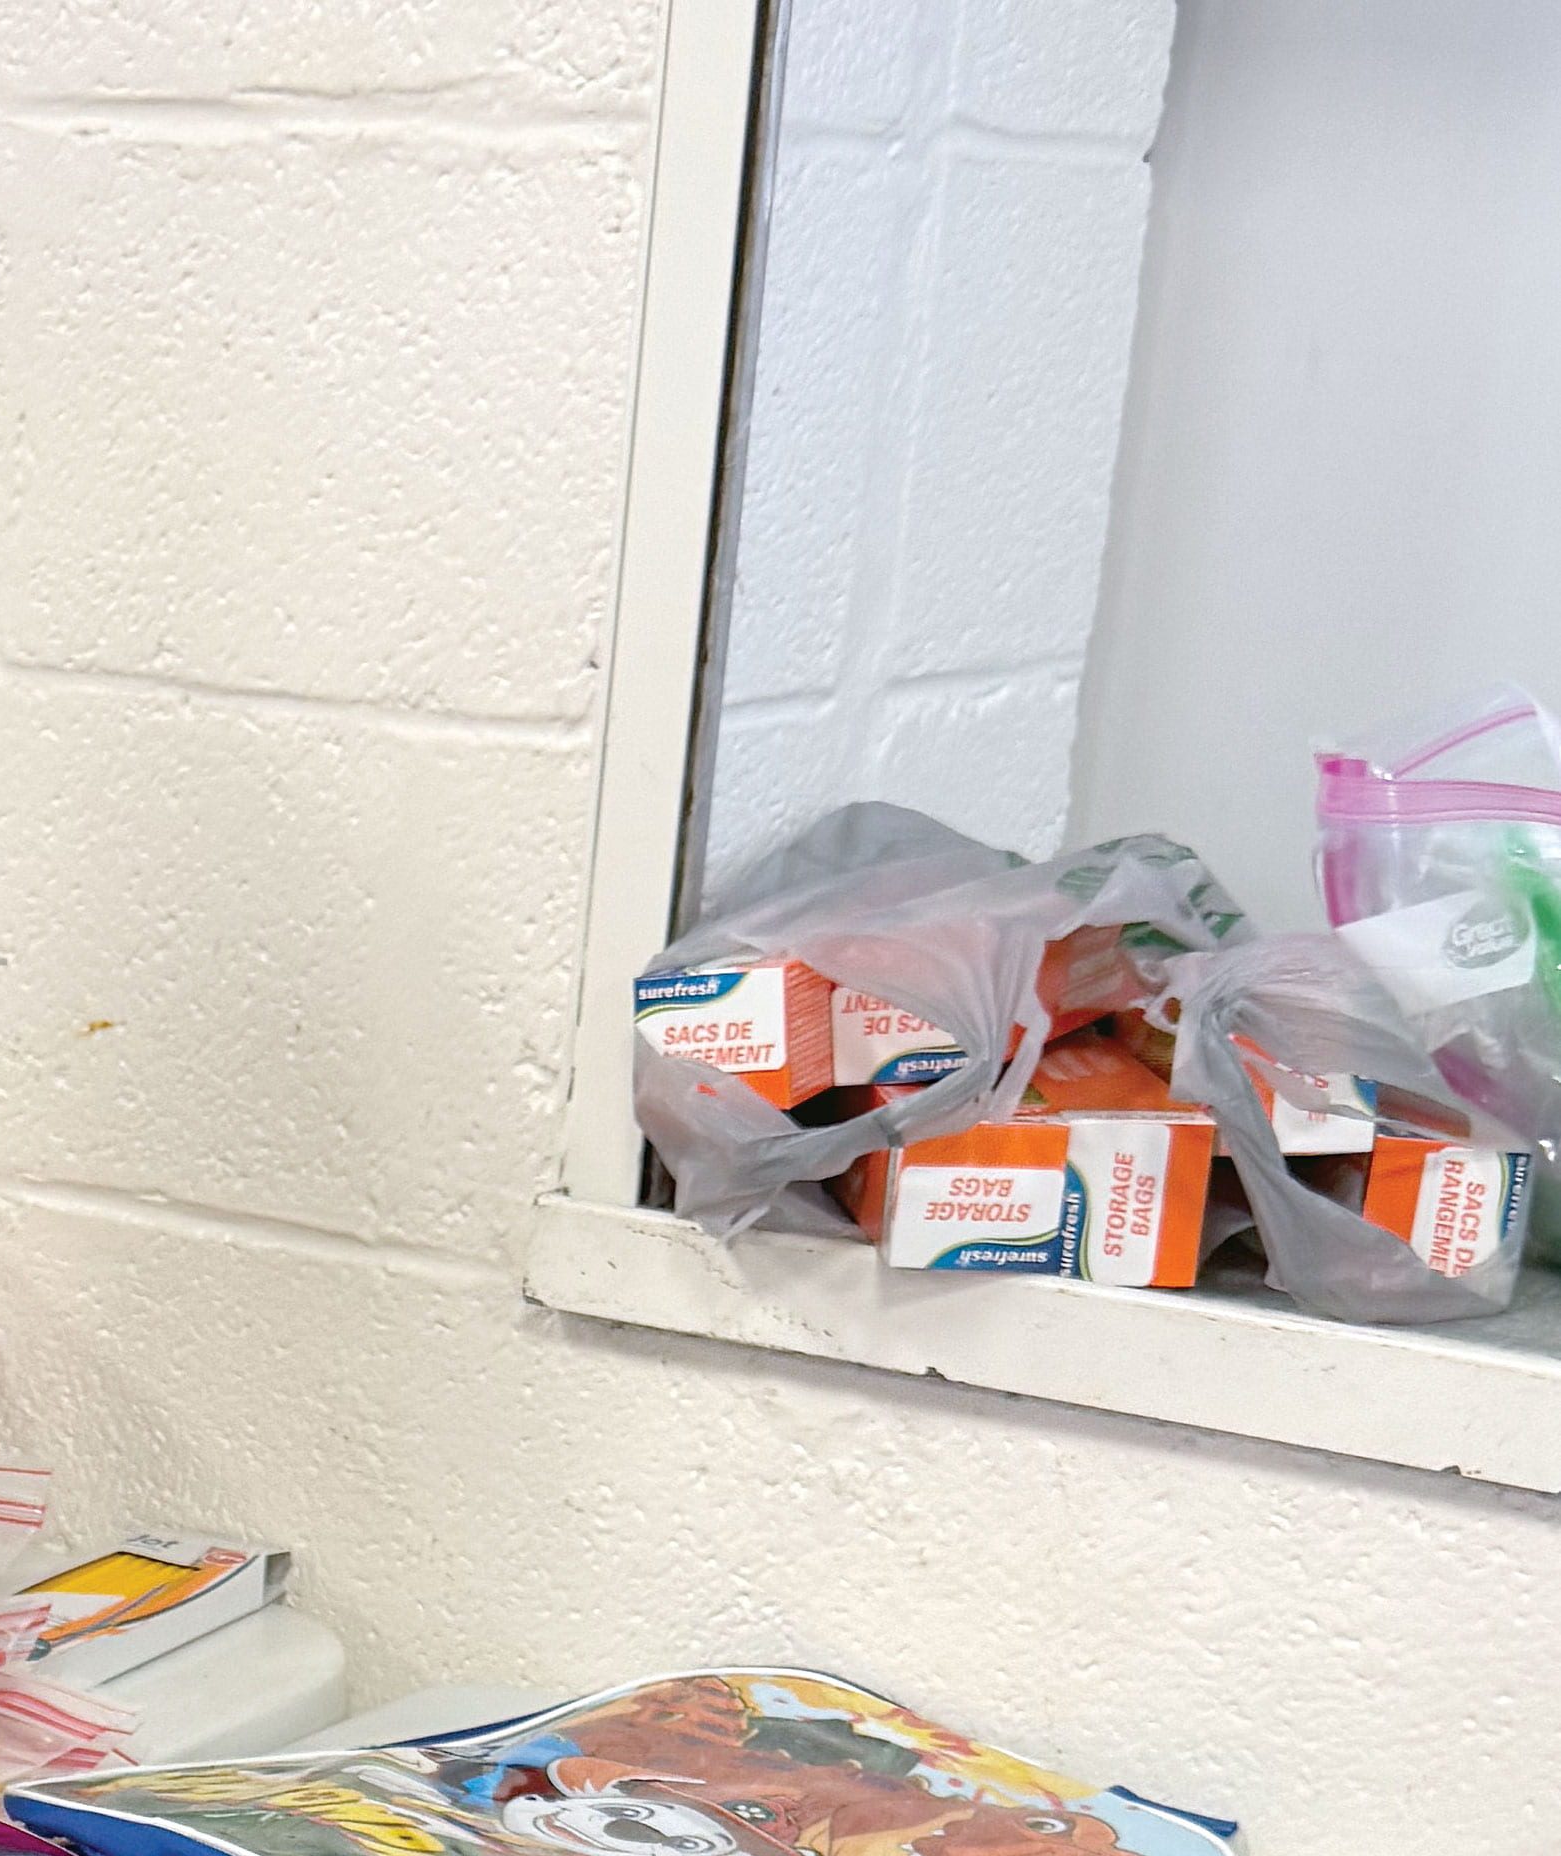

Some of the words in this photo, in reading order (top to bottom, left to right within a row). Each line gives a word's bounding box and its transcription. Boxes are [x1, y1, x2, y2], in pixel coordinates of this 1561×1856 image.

[638, 978, 721, 1001] surefresh
[663, 1023, 719, 1045] SACS
[725, 1019, 754, 1041] DE
[949, 1177, 1014, 1197] BAGS
[924, 1202, 1032, 1222] STORAGE
[1103, 1151, 1135, 1258] STORAGE
[1130, 1174, 1156, 1237] BAGS
[1457, 1181, 1486, 1242] SACS
[959, 1248, 1049, 1266] surefresh
